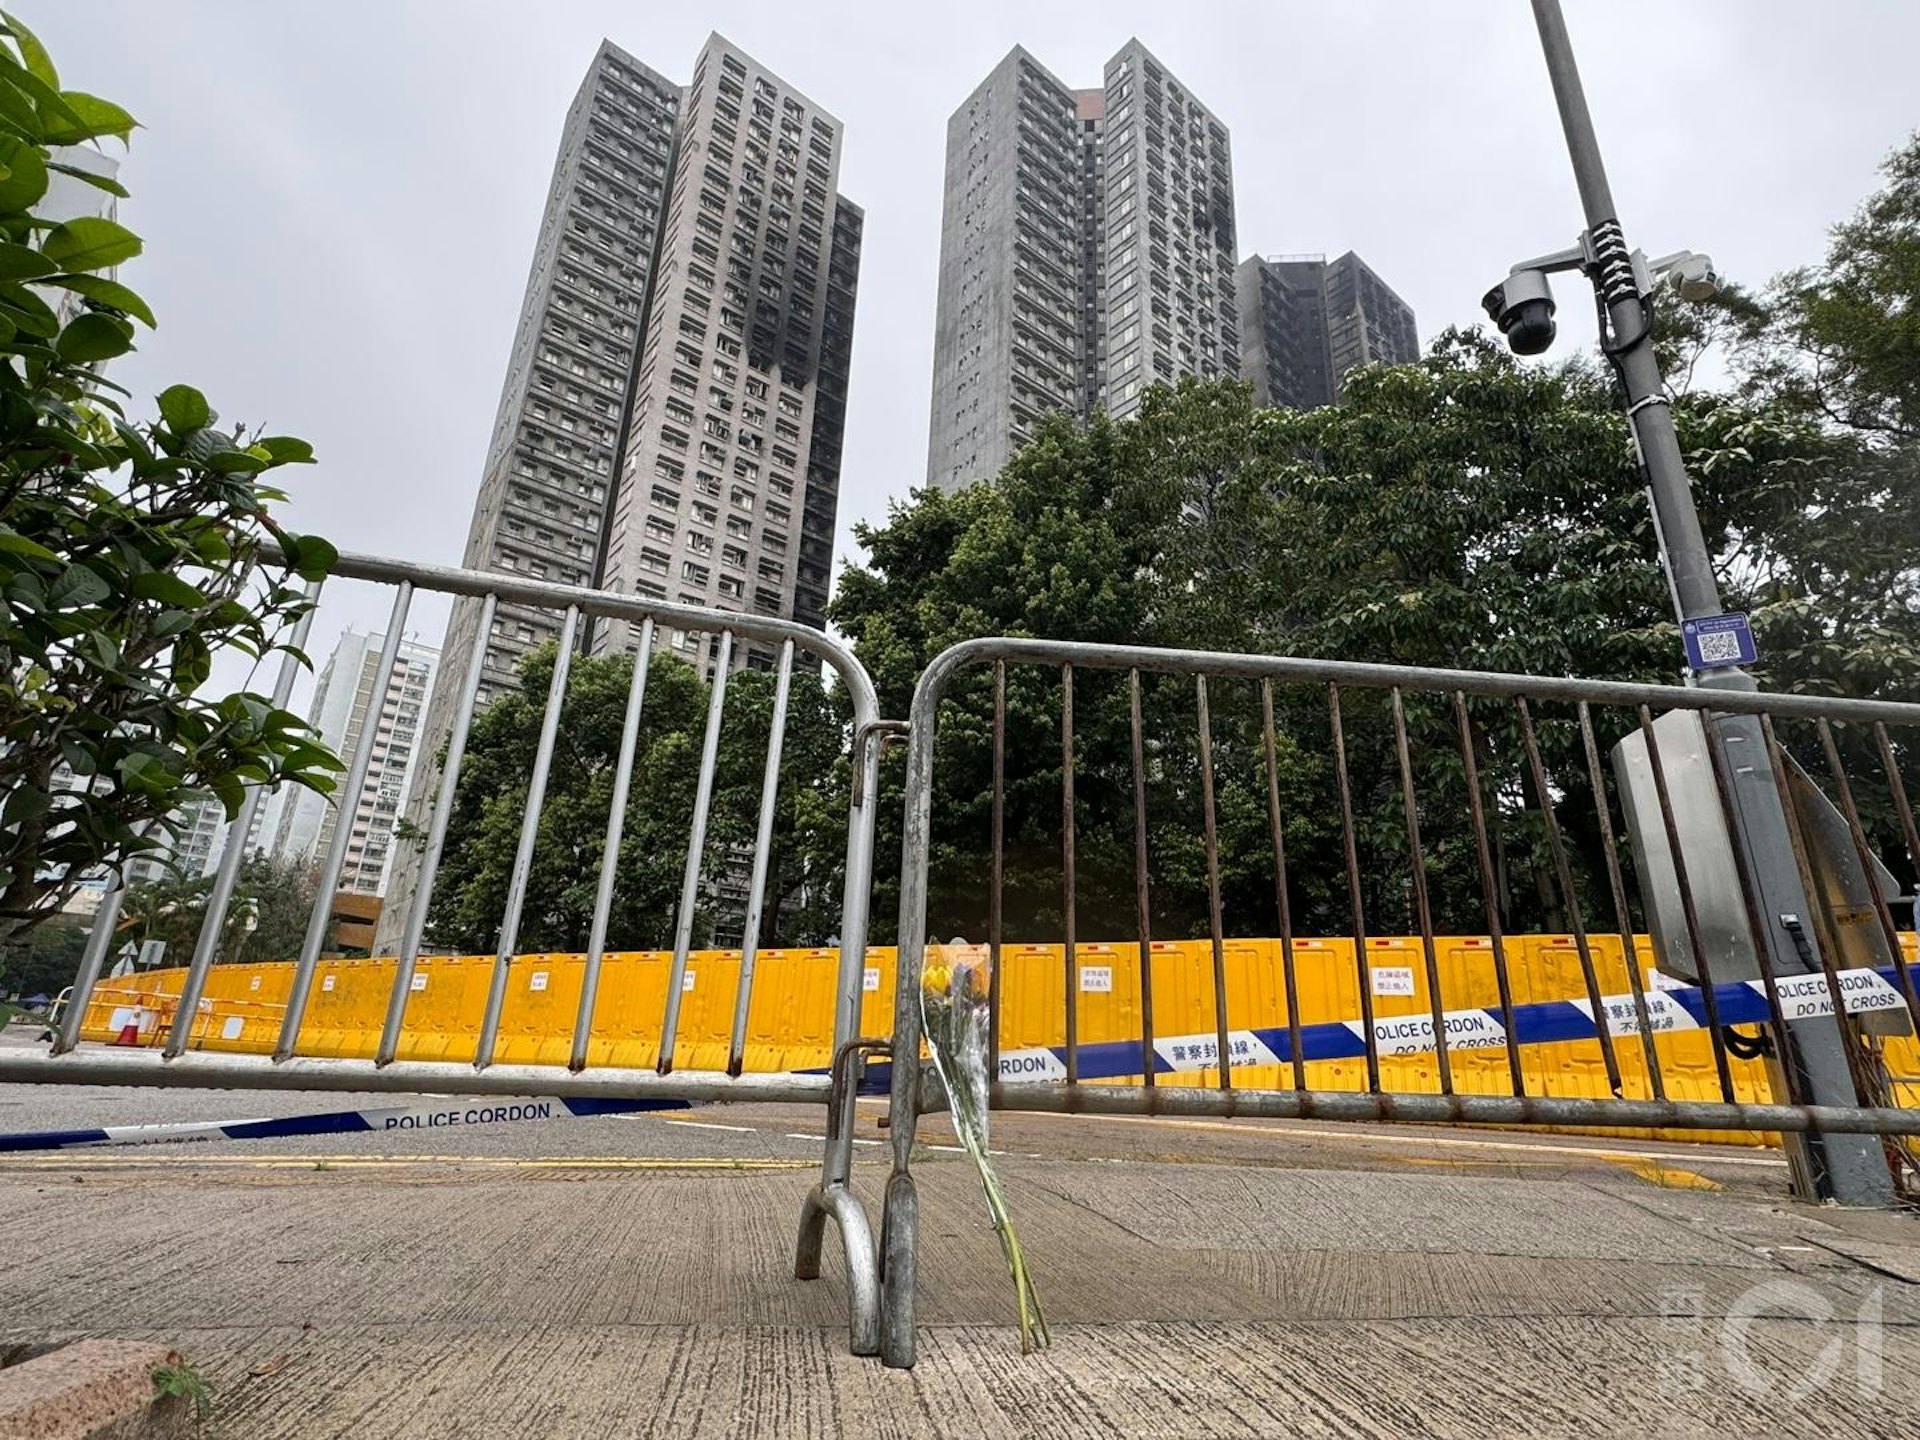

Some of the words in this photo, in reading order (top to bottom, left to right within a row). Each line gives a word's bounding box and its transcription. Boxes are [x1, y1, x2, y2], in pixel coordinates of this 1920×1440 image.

[1777, 982, 1816, 998] OLICE
[1797, 1003, 1816, 1016] DO
[1852, 993, 1895, 1009] CROSS
[1376, 1023, 1419, 1040] OLICE
[386, 1111, 460, 1130] POLICE
